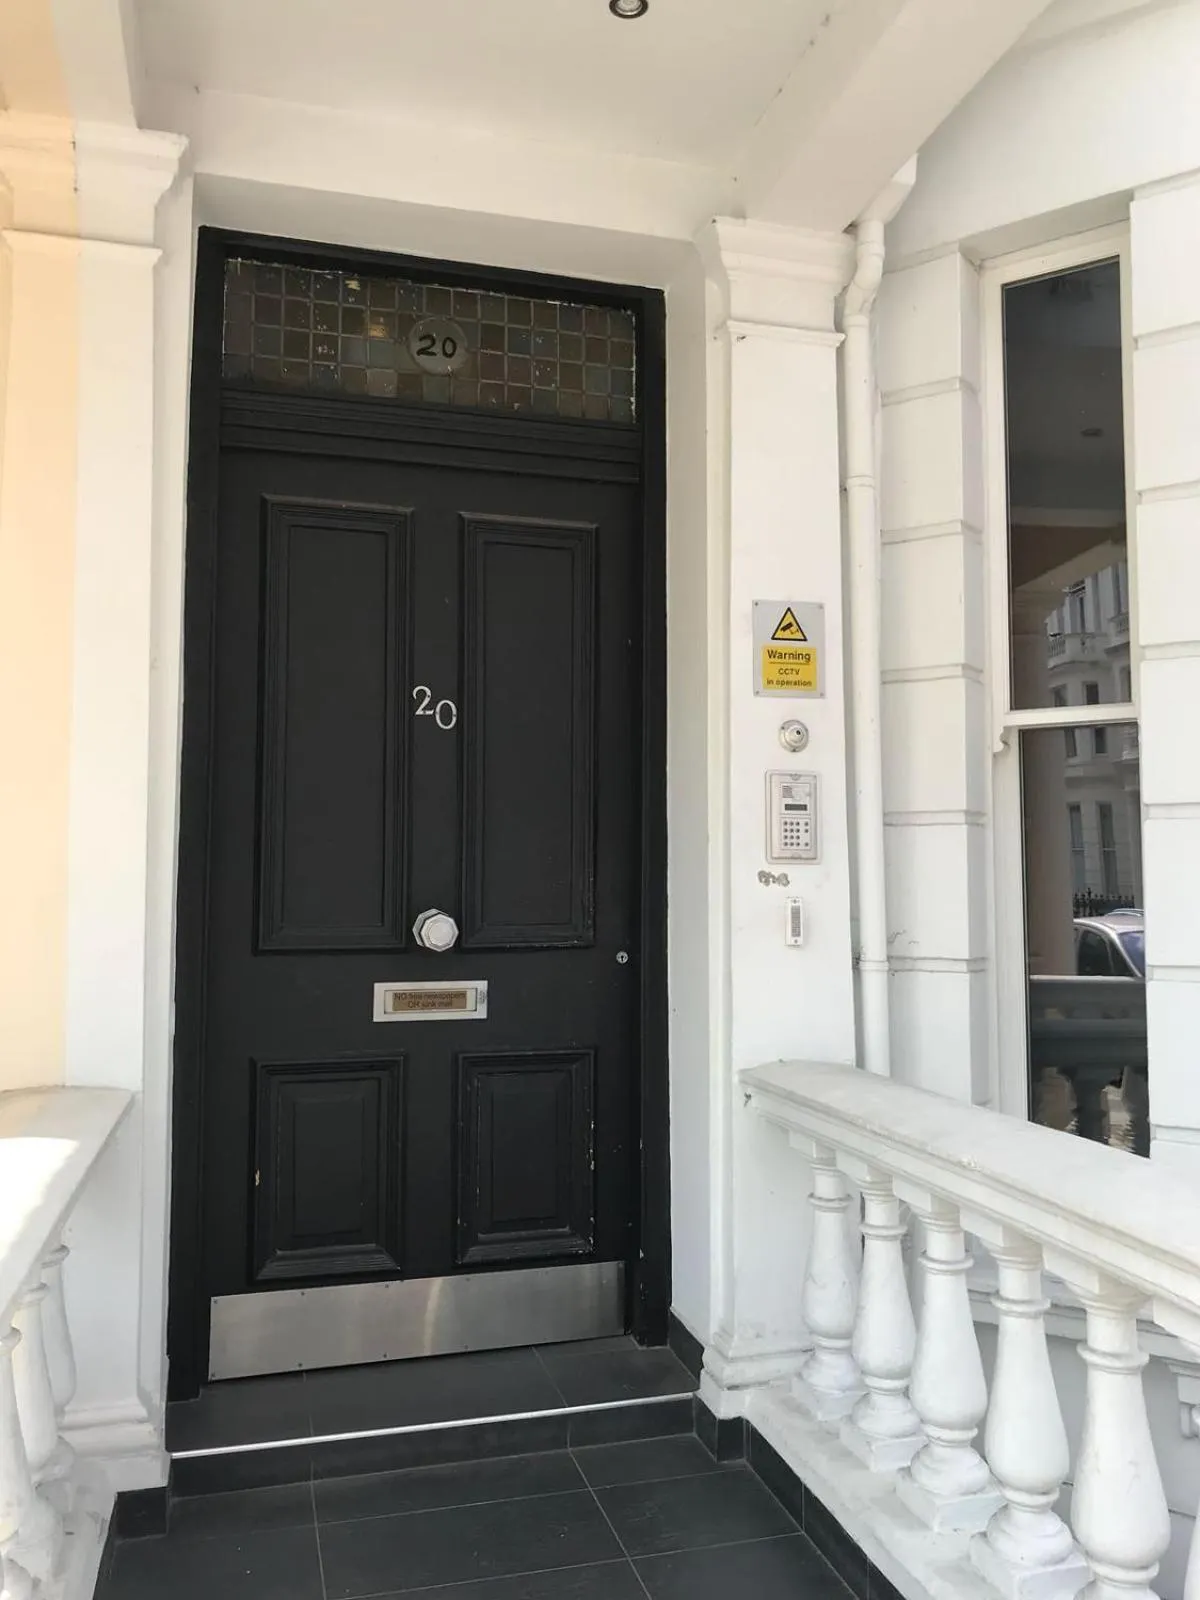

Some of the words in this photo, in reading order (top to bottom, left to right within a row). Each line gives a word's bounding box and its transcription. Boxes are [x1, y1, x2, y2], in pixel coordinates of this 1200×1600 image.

[416, 334, 457, 358] 20
[767, 649, 811, 663] Warning
[413, 685, 457, 729] 20
[393, 992, 407, 1000] NO
